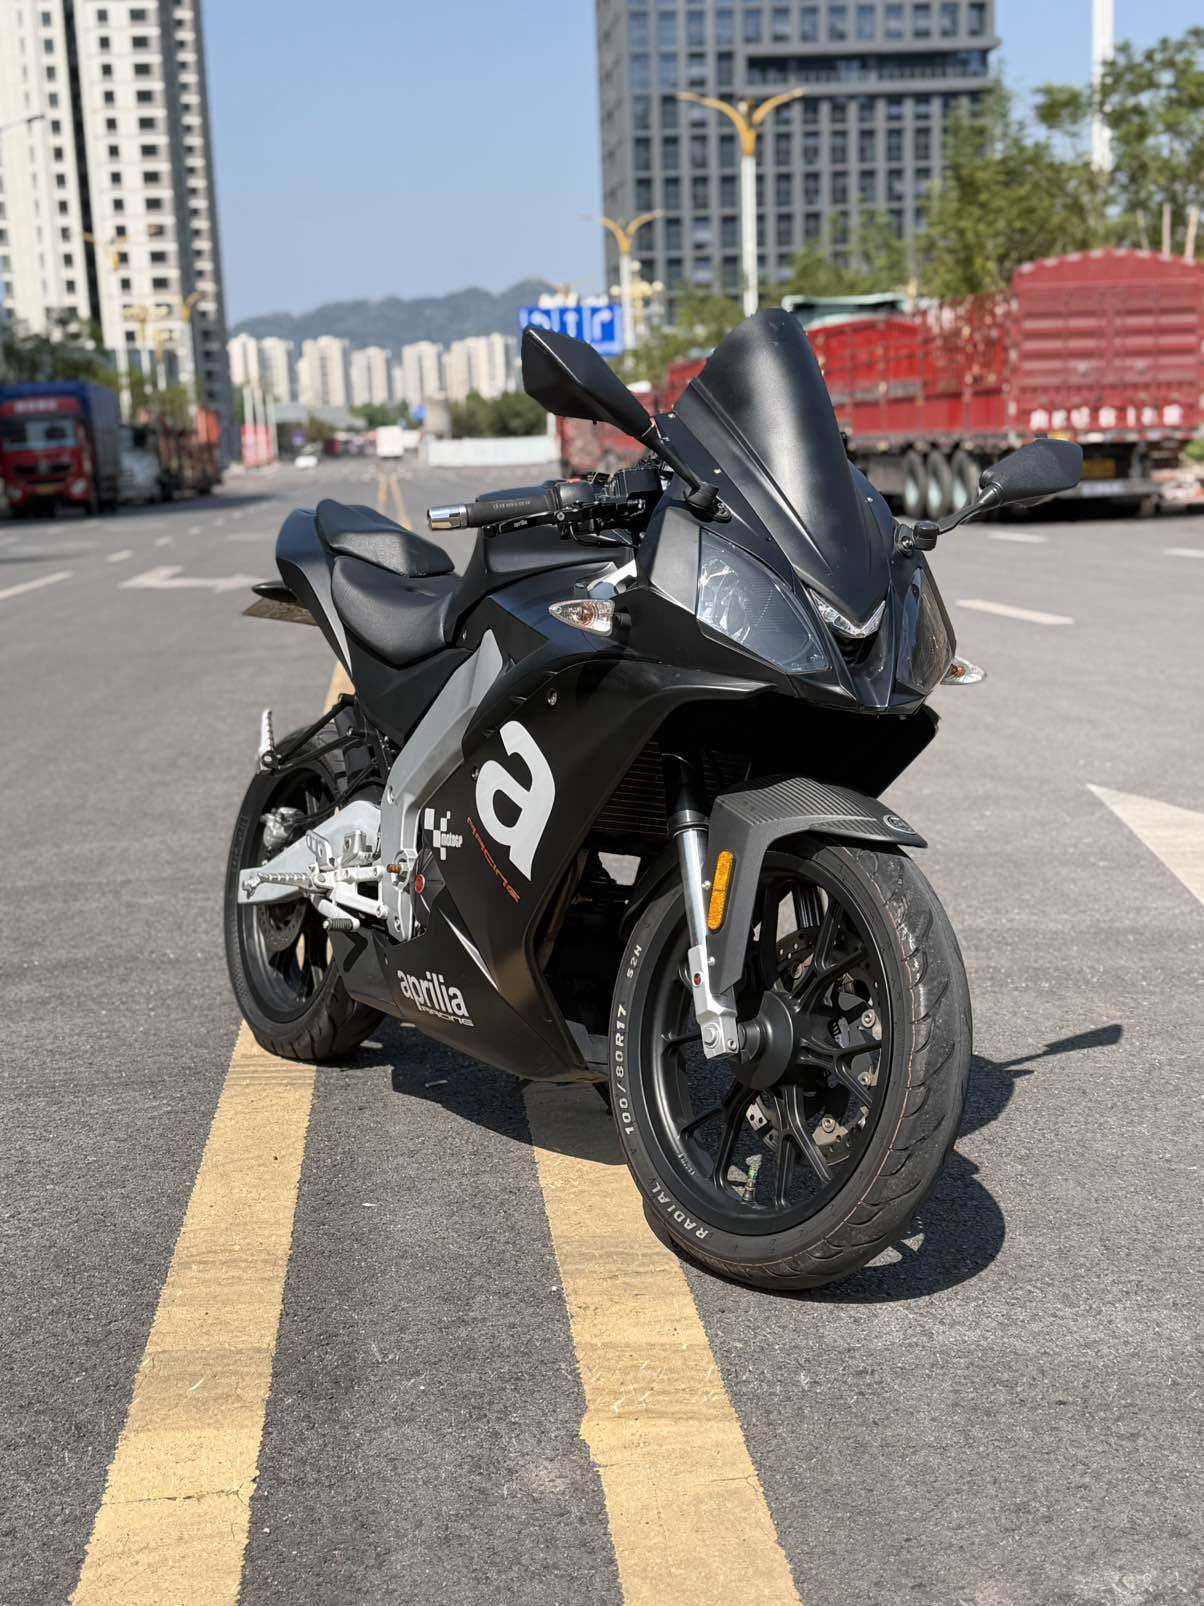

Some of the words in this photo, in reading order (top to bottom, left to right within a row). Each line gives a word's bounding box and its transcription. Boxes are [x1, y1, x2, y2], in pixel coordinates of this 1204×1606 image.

[397, 969, 470, 1018] aprilia
[614, 1004, 635, 1135] 100/80R17
[651, 1181, 709, 1239] RADIAL
